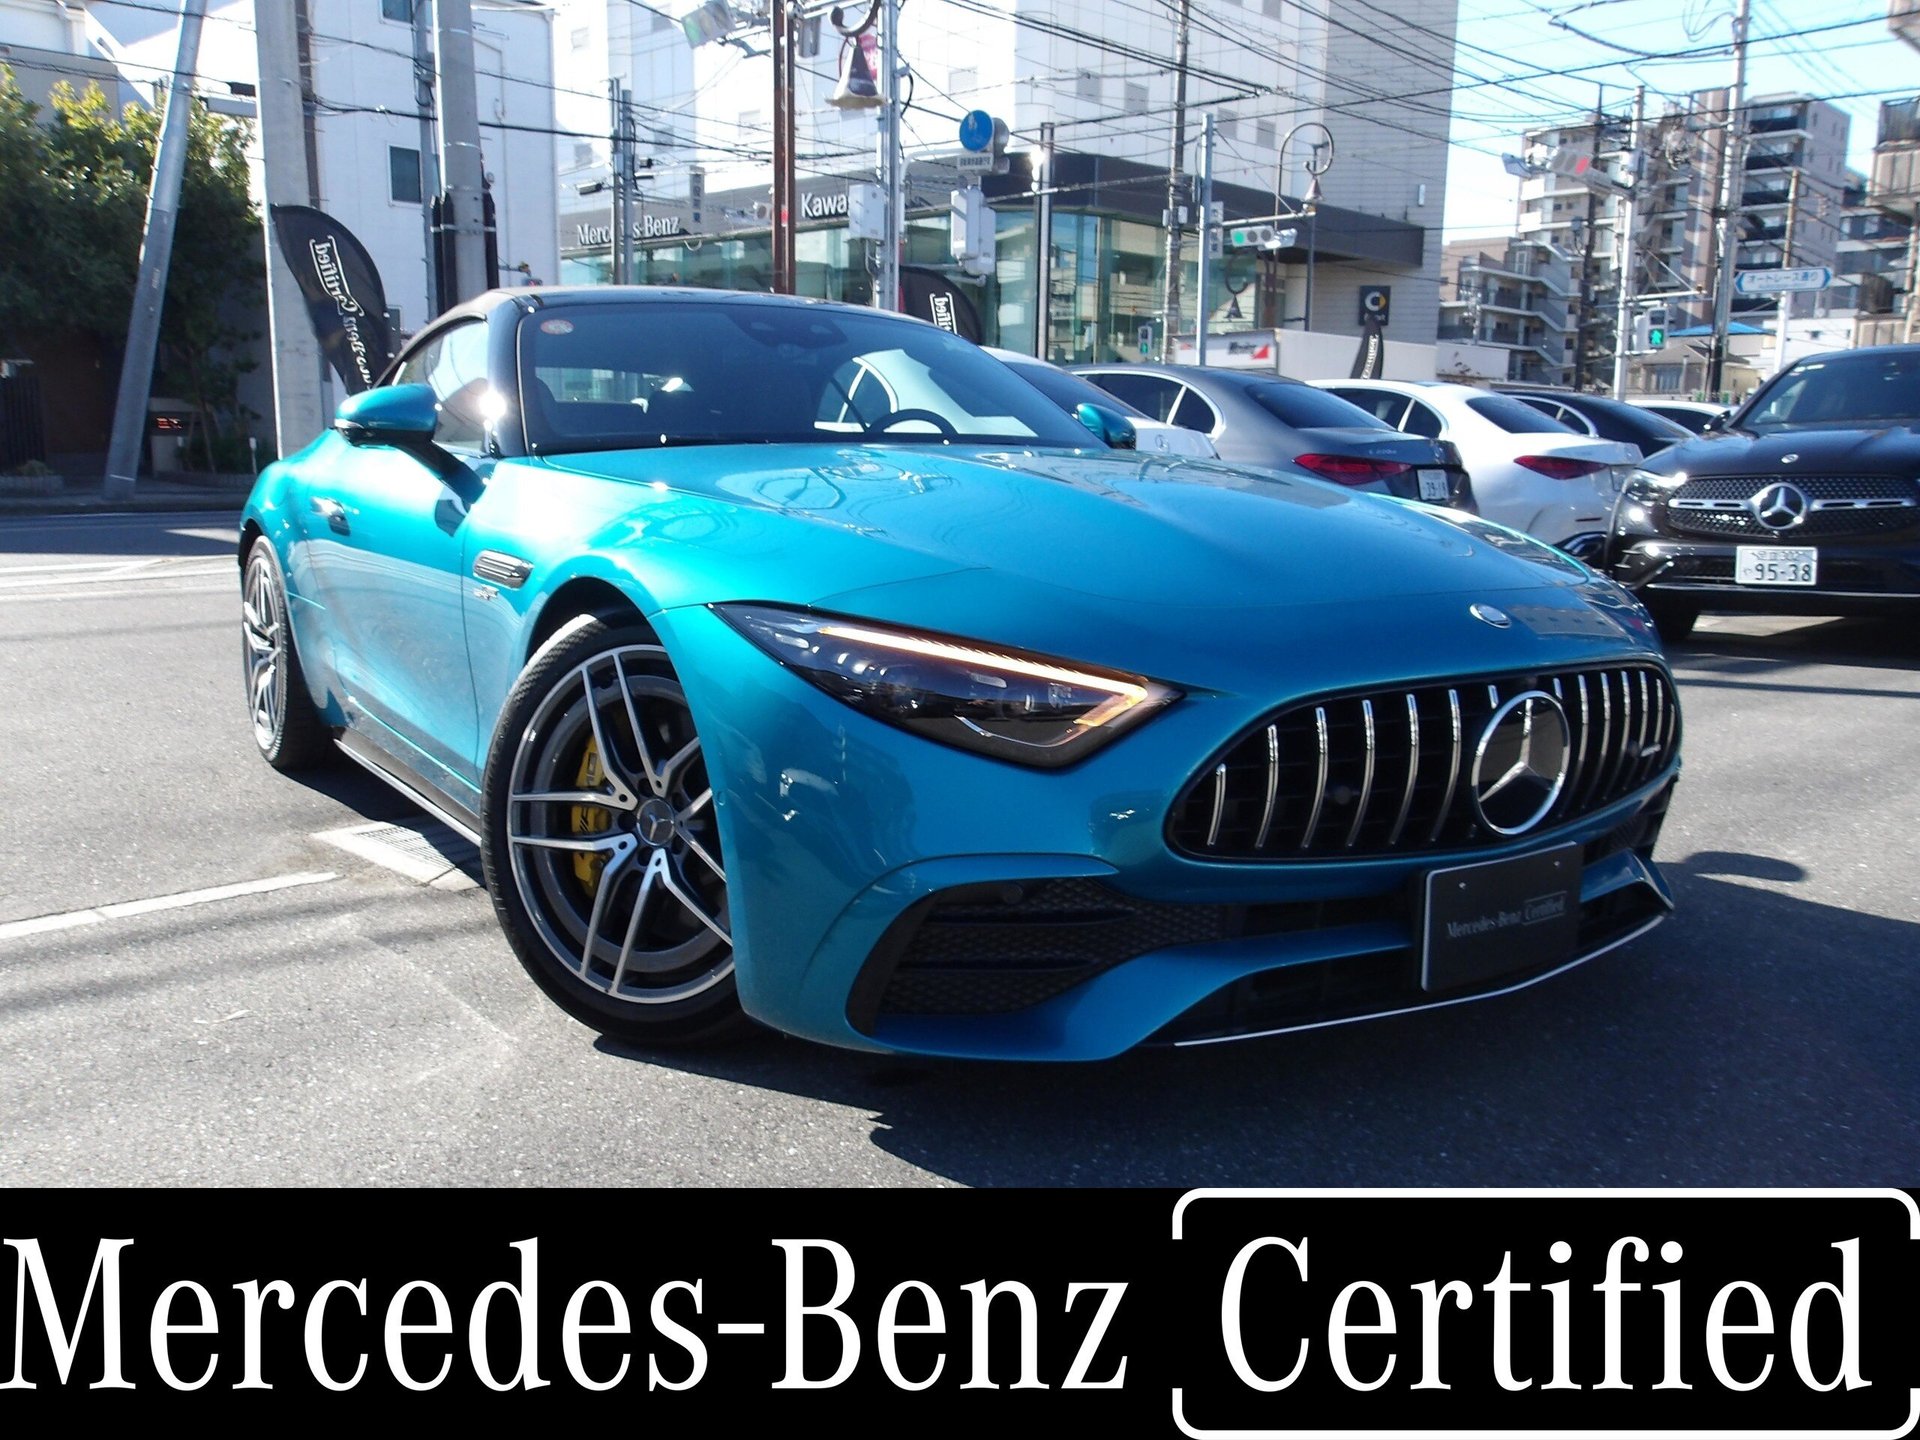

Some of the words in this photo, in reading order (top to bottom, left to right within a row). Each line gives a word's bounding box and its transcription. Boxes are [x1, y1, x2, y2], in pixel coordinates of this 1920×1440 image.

[801, 192, 850, 218] Kawa
[577, 215, 680, 245] Mercs-Benz
[1755, 563, 1812, 582] 95-38
